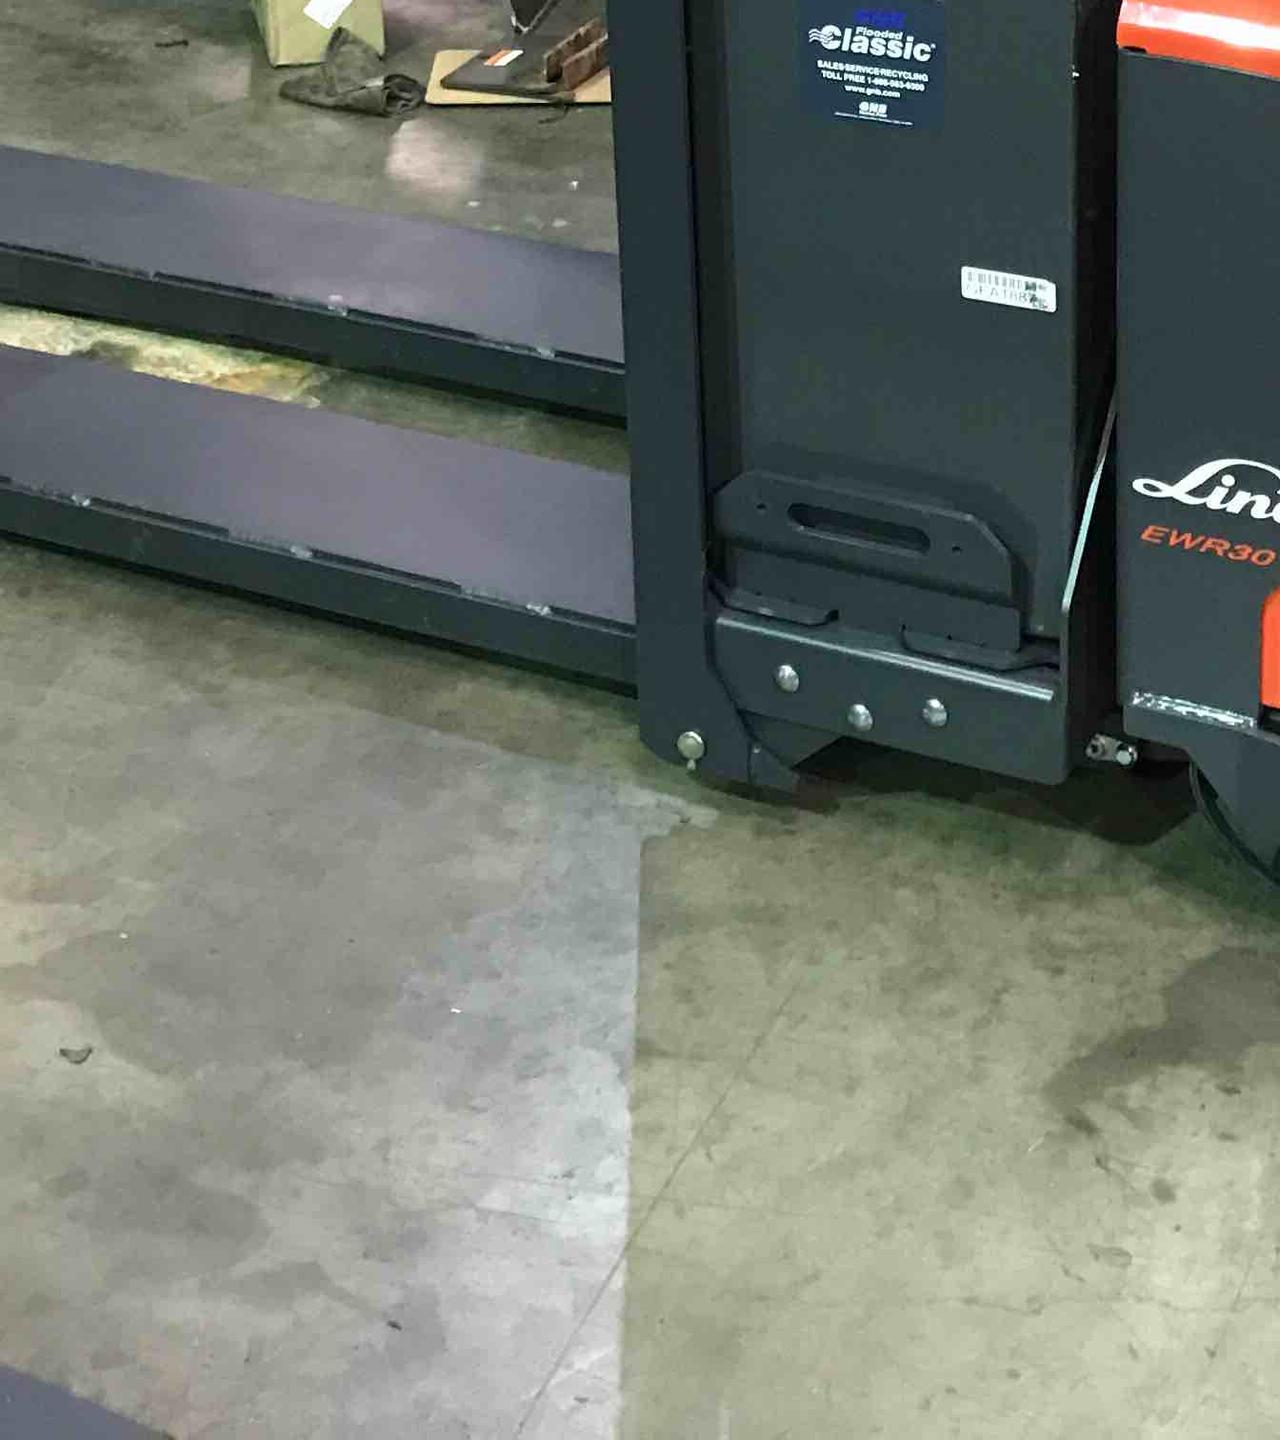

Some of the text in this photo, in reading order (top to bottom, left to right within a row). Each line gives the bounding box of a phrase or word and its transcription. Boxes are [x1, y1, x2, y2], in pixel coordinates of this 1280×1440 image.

[820, 24, 932, 62] Classic
[855, 25, 903, 40] Flooded
[821, 70, 842, 81] TOLL
[843, 73, 865, 85] FREE
[1140, 524, 1277, 567] EWR30
